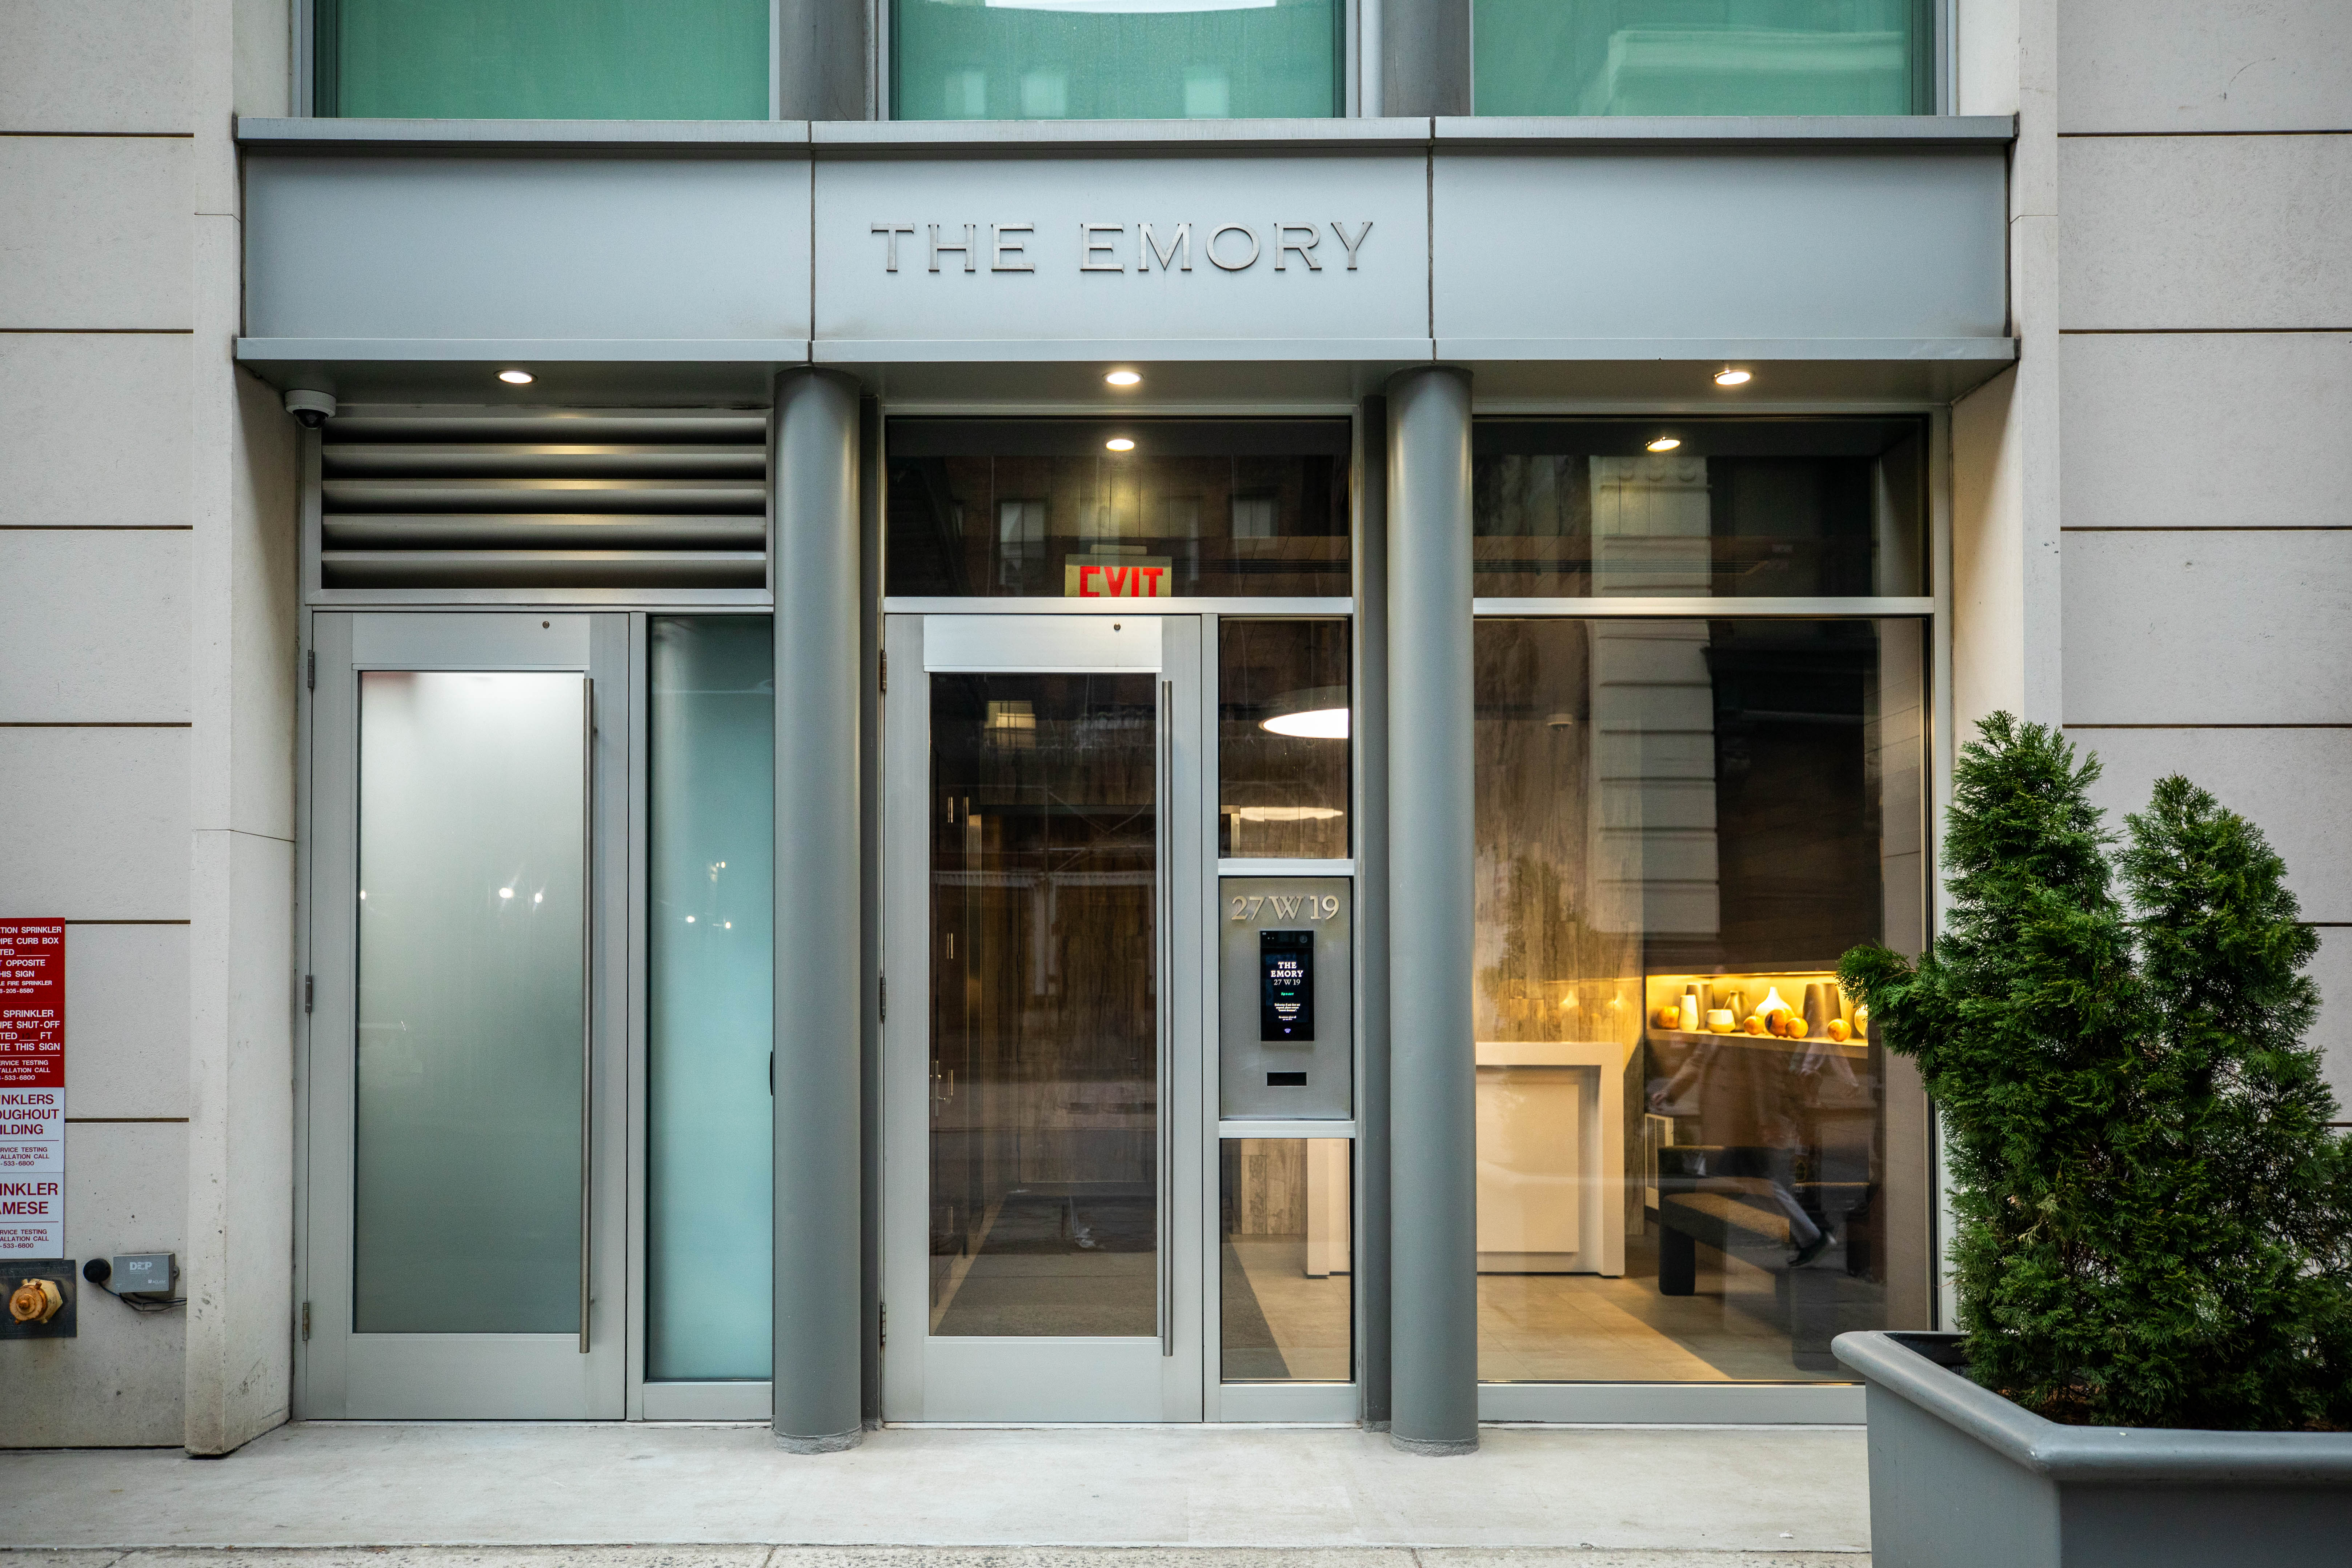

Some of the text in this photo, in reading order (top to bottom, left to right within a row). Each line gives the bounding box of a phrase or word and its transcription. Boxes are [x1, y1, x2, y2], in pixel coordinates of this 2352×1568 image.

[871, 221, 1373, 272] THE EMORY
[1231, 895, 1340, 920] 27 W 19
[0, 1109, 59, 1120] UGHOUT
[0, 1202, 48, 1214] MESE
[130, 1262, 152, 1270] DEP
